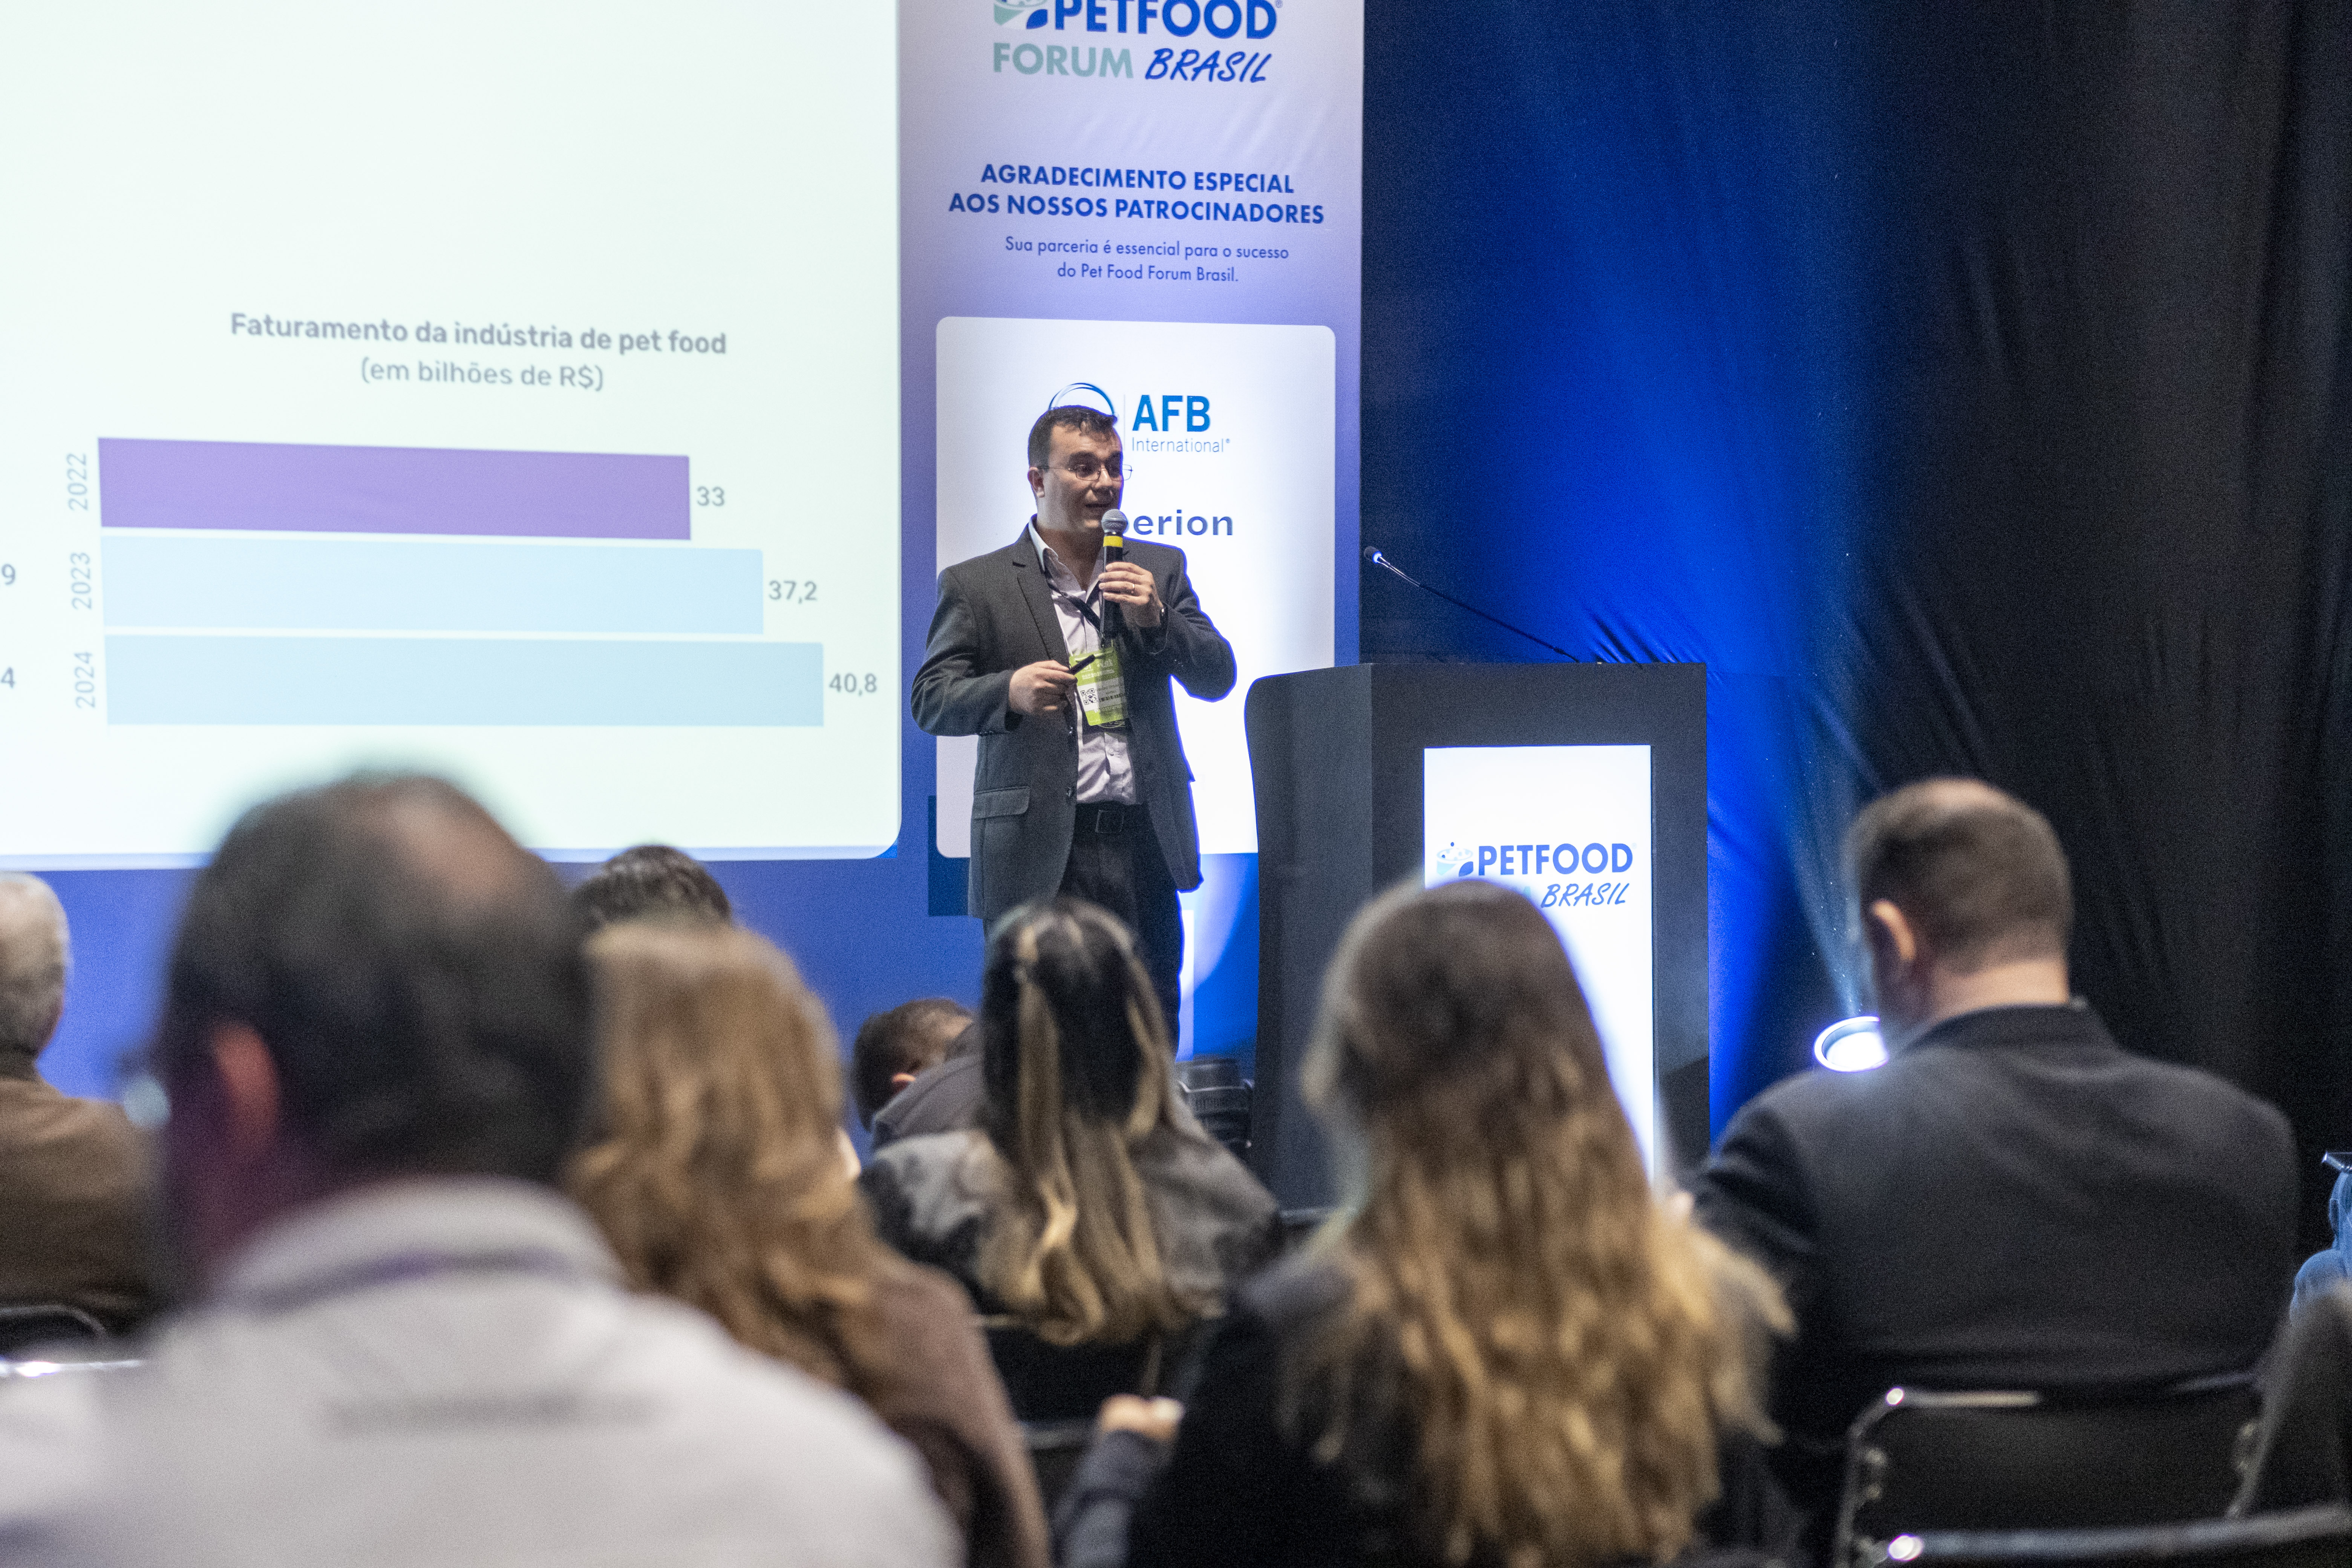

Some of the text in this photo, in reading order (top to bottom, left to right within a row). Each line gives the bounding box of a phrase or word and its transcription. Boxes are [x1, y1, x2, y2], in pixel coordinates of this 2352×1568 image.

[1055, 0, 1277, 39] PETFOOD
[993, 43, 1271, 83] FORUM BRASIL
[981, 164, 1294, 193] AGRADECIMENTO ESPECIAL
[949, 193, 1324, 224] AOS NOSSOS PATROCINADORES
[1005, 236, 1289, 260] Sua parceria é essencial para o sucesso
[1057, 262, 1239, 282] do Pet Food Forum Brasil.
[231, 312, 726, 355] Faturamento da indústria de pet food
[361, 357, 603, 392] (em bilhões de R$)
[1132, 395, 1210, 432] AFB
[66, 453, 89, 511] 2022
[697, 486, 725, 507] 33
[1125, 510, 1233, 536] erion
[69, 552, 92, 610] 2023
[769, 580, 817, 604] 37,2
[74, 651, 96, 708] 2024
[829, 673, 877, 696] 40,8
[1478, 843, 1633, 876] PETFOOD
[1540, 883, 1629, 908] BRASIL
